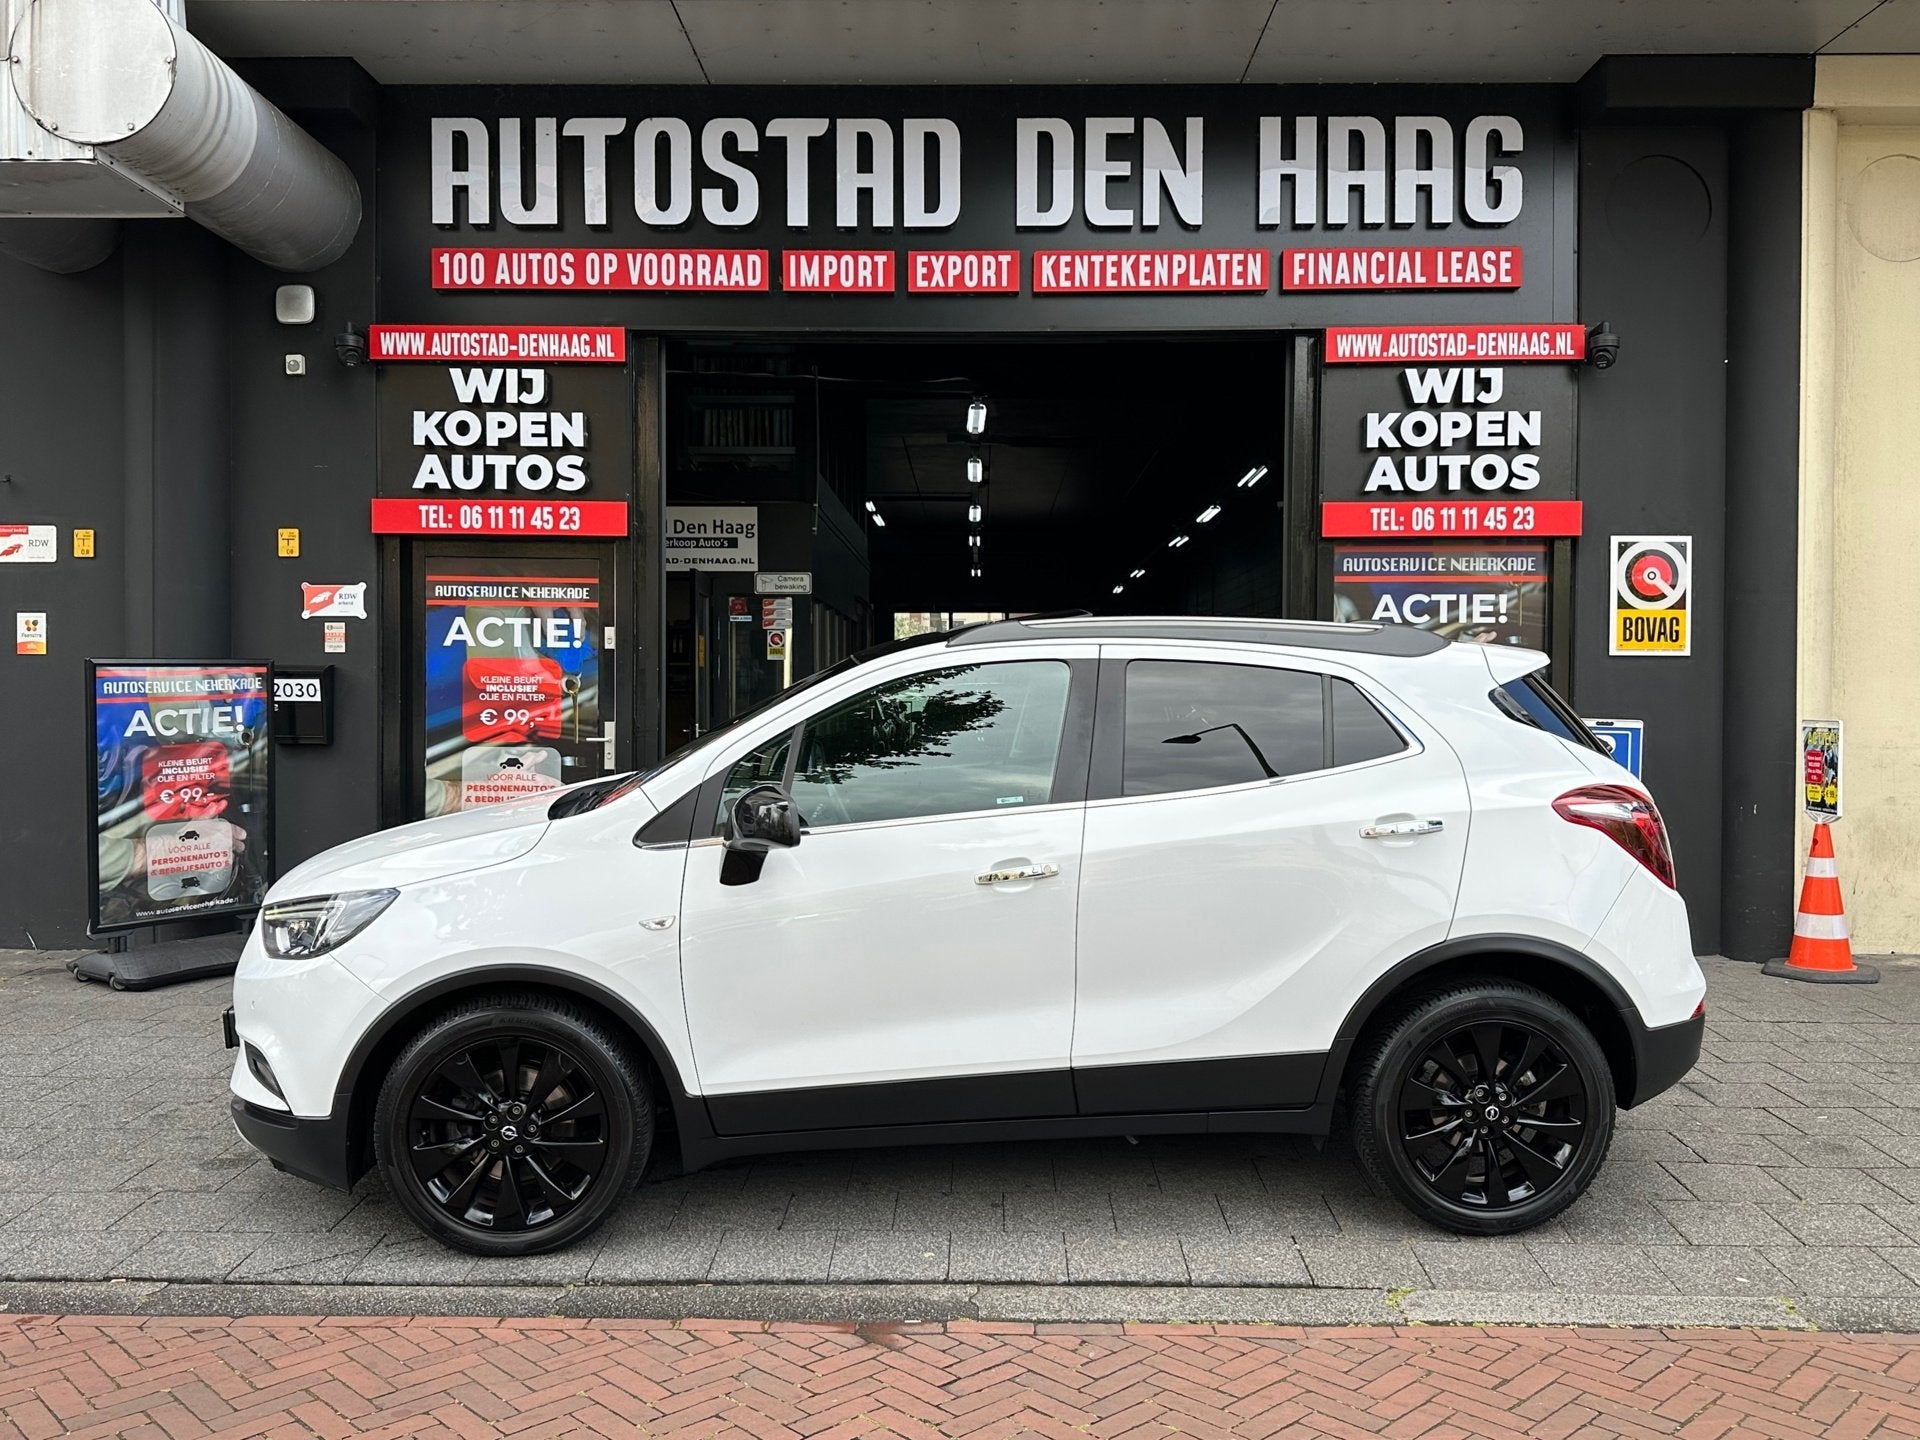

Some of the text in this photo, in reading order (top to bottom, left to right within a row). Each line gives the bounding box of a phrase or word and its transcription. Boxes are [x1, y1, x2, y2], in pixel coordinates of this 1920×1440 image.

[431, 115, 1524, 227] AUTOSTAD DEN HAAG
[439, 252, 762, 287] 100 AUTOS OP VOORRAAD
[789, 254, 887, 288] IMPORT
[917, 254, 1010, 288] EXPORT
[1041, 253, 1262, 287] KENTEKENPLATEN
[1294, 250, 1513, 285] FINANCIAL LEASE
[380, 332, 615, 357] WWW.AUTOSTAD-DENHAAG.NL
[1336, 332, 1575, 358] WWW.AUTOSTAD-DENHAAG.NL
[449, 367, 545, 404] WIJ
[1404, 367, 1504, 404] WIJ
[413, 410, 584, 447] KOPEN
[1366, 410, 1541, 448] KOPEN
[412, 453, 586, 491] AUTOS
[1364, 453, 1541, 491] AUTOS
[419, 505, 581, 530] TEL: 06 11 11 45 23
[674, 519, 707, 534] Den
[713, 519, 756, 538] Haag
[1370, 506, 1535, 531] TEL: 06 11 11 45 23
[699, 538, 728, 547] Auto's
[1343, 557, 1536, 572] AUTOSERVICE NEHERKADE
[435, 585, 590, 599] AUTOSERVICE NEHERKADE
[775, 583, 807, 591] bewaking
[1371, 593, 1508, 624] ACTIE!
[443, 616, 583, 648] ACTIE!
[1622, 616, 1680, 643] BOVAG
[103, 677, 262, 694] AUTOSERVICE NEHERKADE
[274, 683, 317, 698] 2030
[480, 676, 544, 684] KLEINE BEURT
[479, 693, 546, 701] OLIE EN FILTER
[124, 706, 244, 737] ACTIE!
[480, 709, 544, 727] € 99,-
[158, 757, 213, 768] KLEINE BEURT
[162, 764, 209, 775] INCLUSIEF
[157, 772, 215, 783] OLIE EN FILTER
[487, 773, 537, 781] VOOR ALLE
[160, 787, 215, 804] € 99,-
[151, 851, 229, 866] PERSONENAUTO'S
[168, 842, 211, 854] VOOR ALLE
[158, 861, 230, 876] BEDRIJFSAUTO'S
